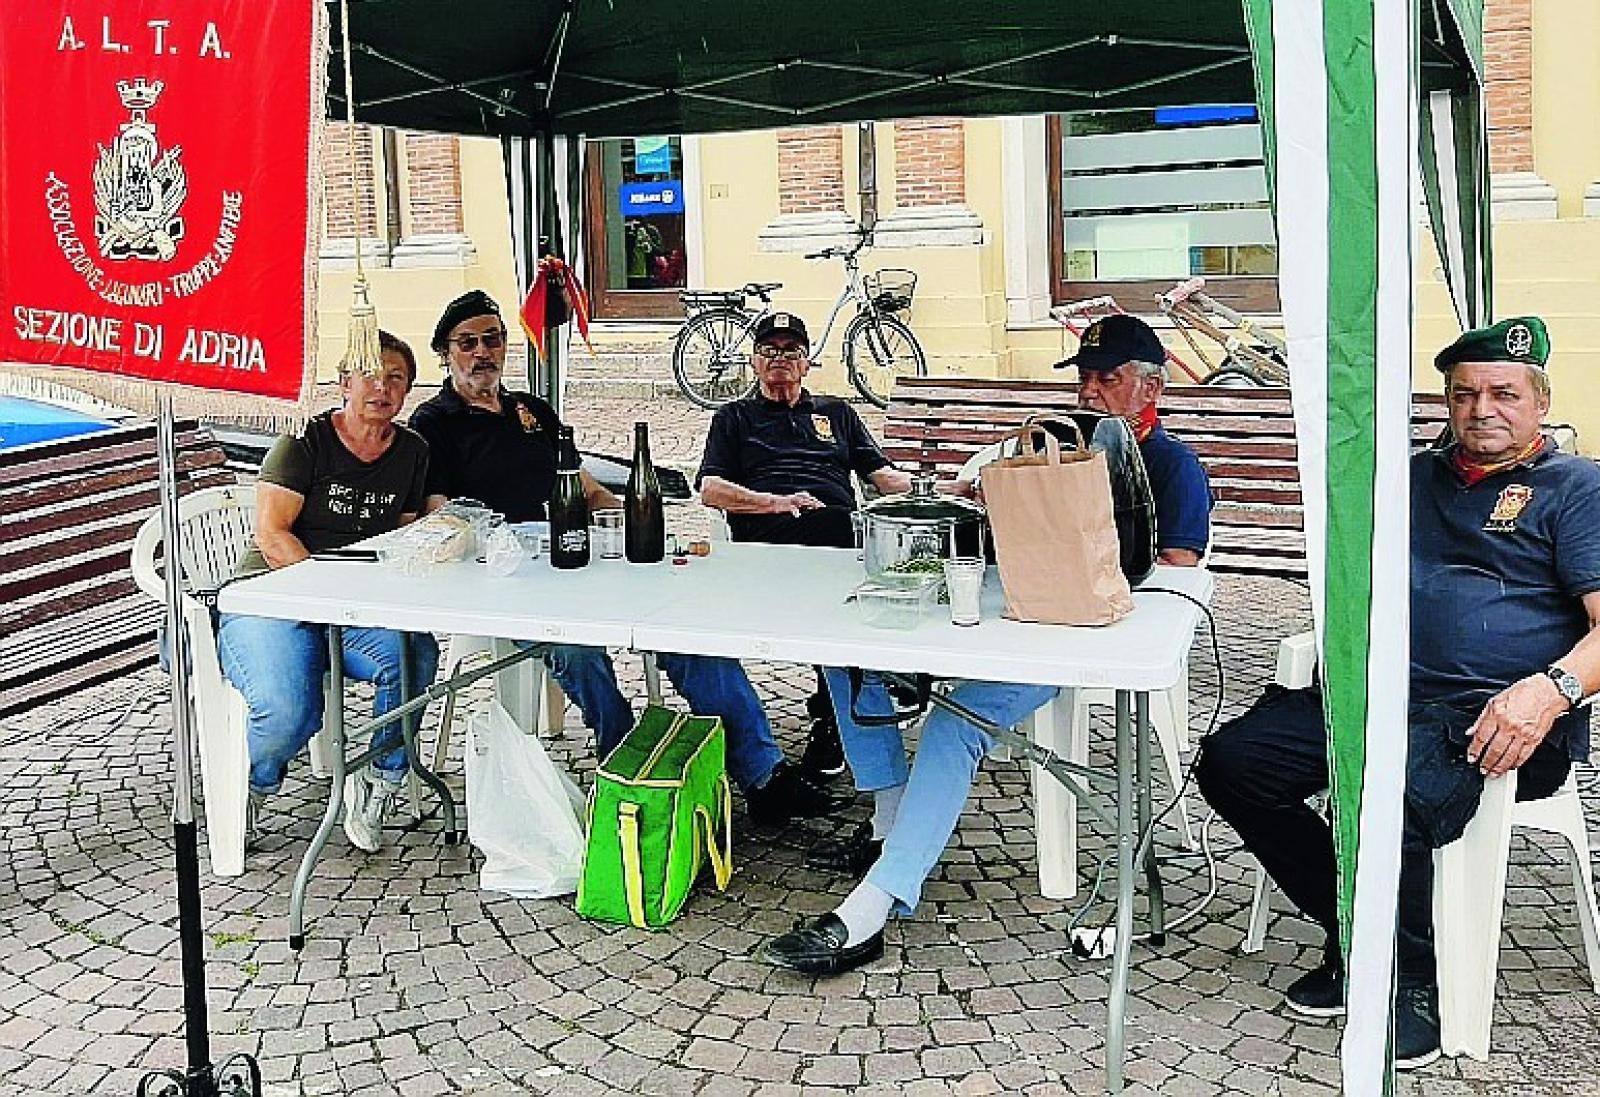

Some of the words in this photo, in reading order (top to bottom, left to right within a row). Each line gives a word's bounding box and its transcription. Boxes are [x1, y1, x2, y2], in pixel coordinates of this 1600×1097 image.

[13, 305, 122, 351] SEZIONE
[134, 322, 163, 361] DI
[178, 328, 267, 373] ADRIA
